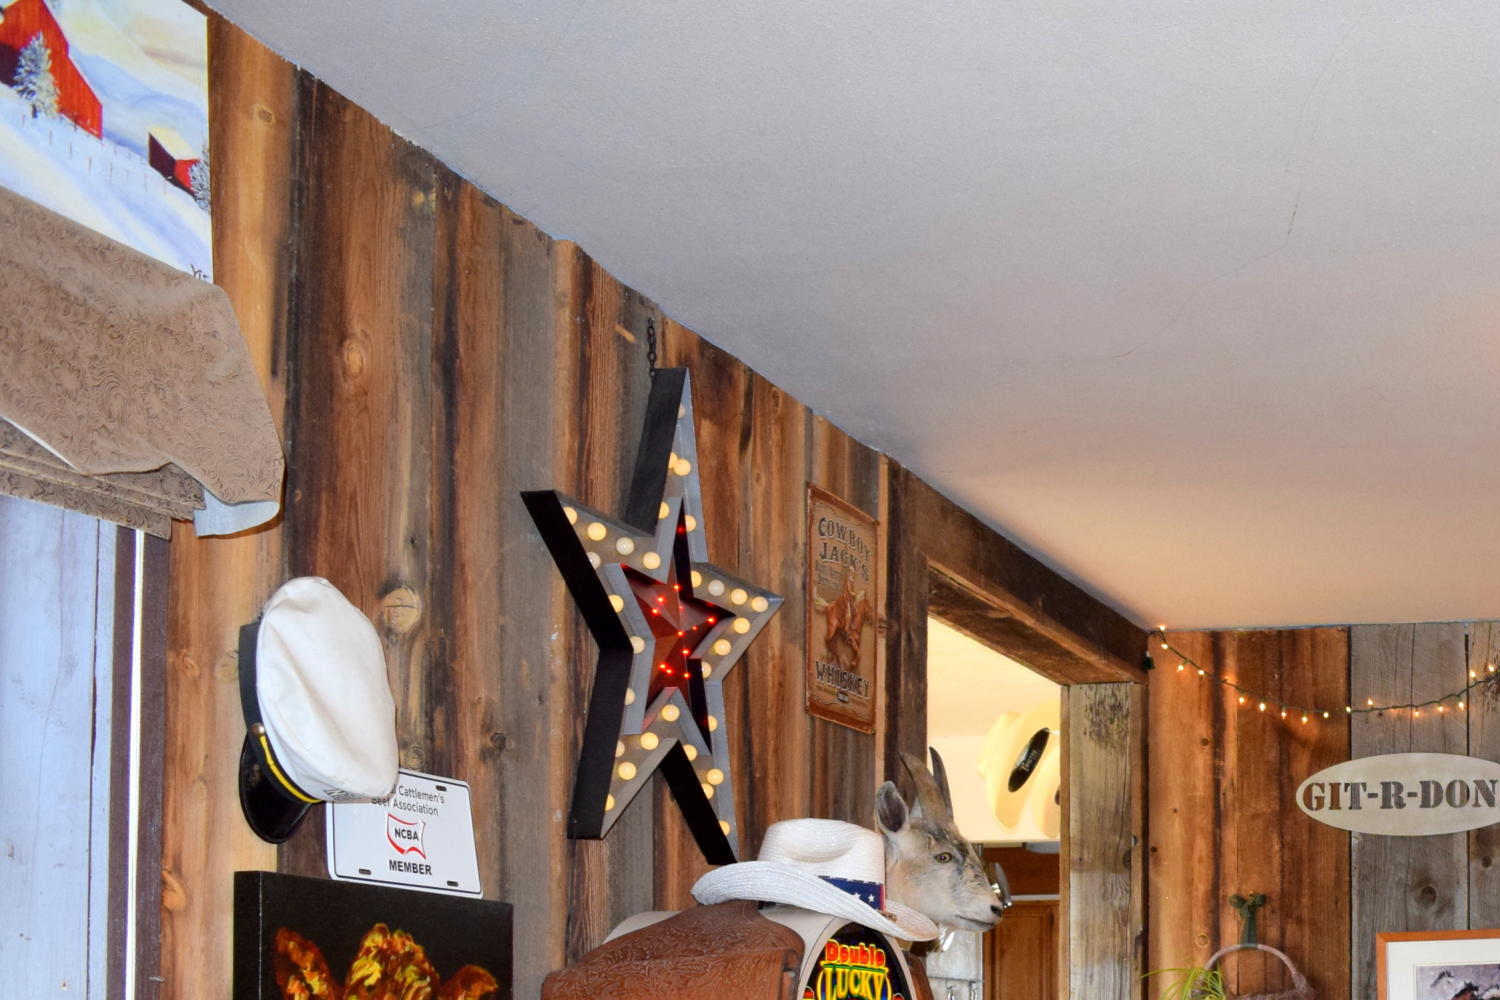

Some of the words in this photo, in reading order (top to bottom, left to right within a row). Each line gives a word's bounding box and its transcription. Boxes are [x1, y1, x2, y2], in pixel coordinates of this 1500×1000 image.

[818, 517, 870, 562] COWBOY
[815, 661, 870, 698] WHISKEY
[399, 786, 445, 804] Cattlemen's
[393, 798, 439, 816] Association
[394, 827, 419, 841] NCBA
[389, 859, 432, 876] MEMBER
[825, 939, 885, 967] Double
